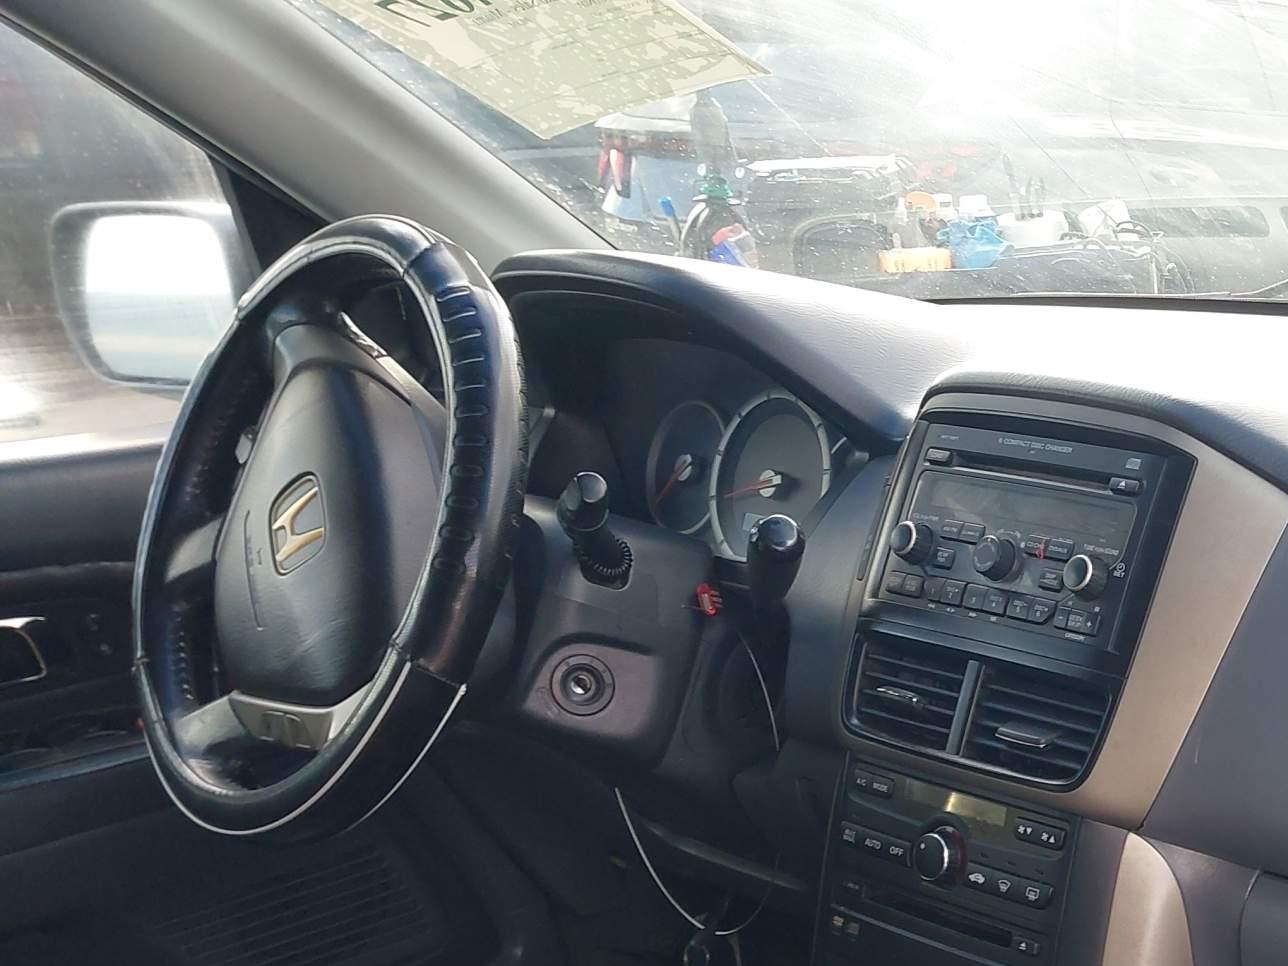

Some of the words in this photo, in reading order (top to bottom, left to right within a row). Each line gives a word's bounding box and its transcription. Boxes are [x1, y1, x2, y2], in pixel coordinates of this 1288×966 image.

[872, 782, 889, 793] MODE
[864, 838, 882, 850] AUTO
[889, 846, 905, 857] OFF
